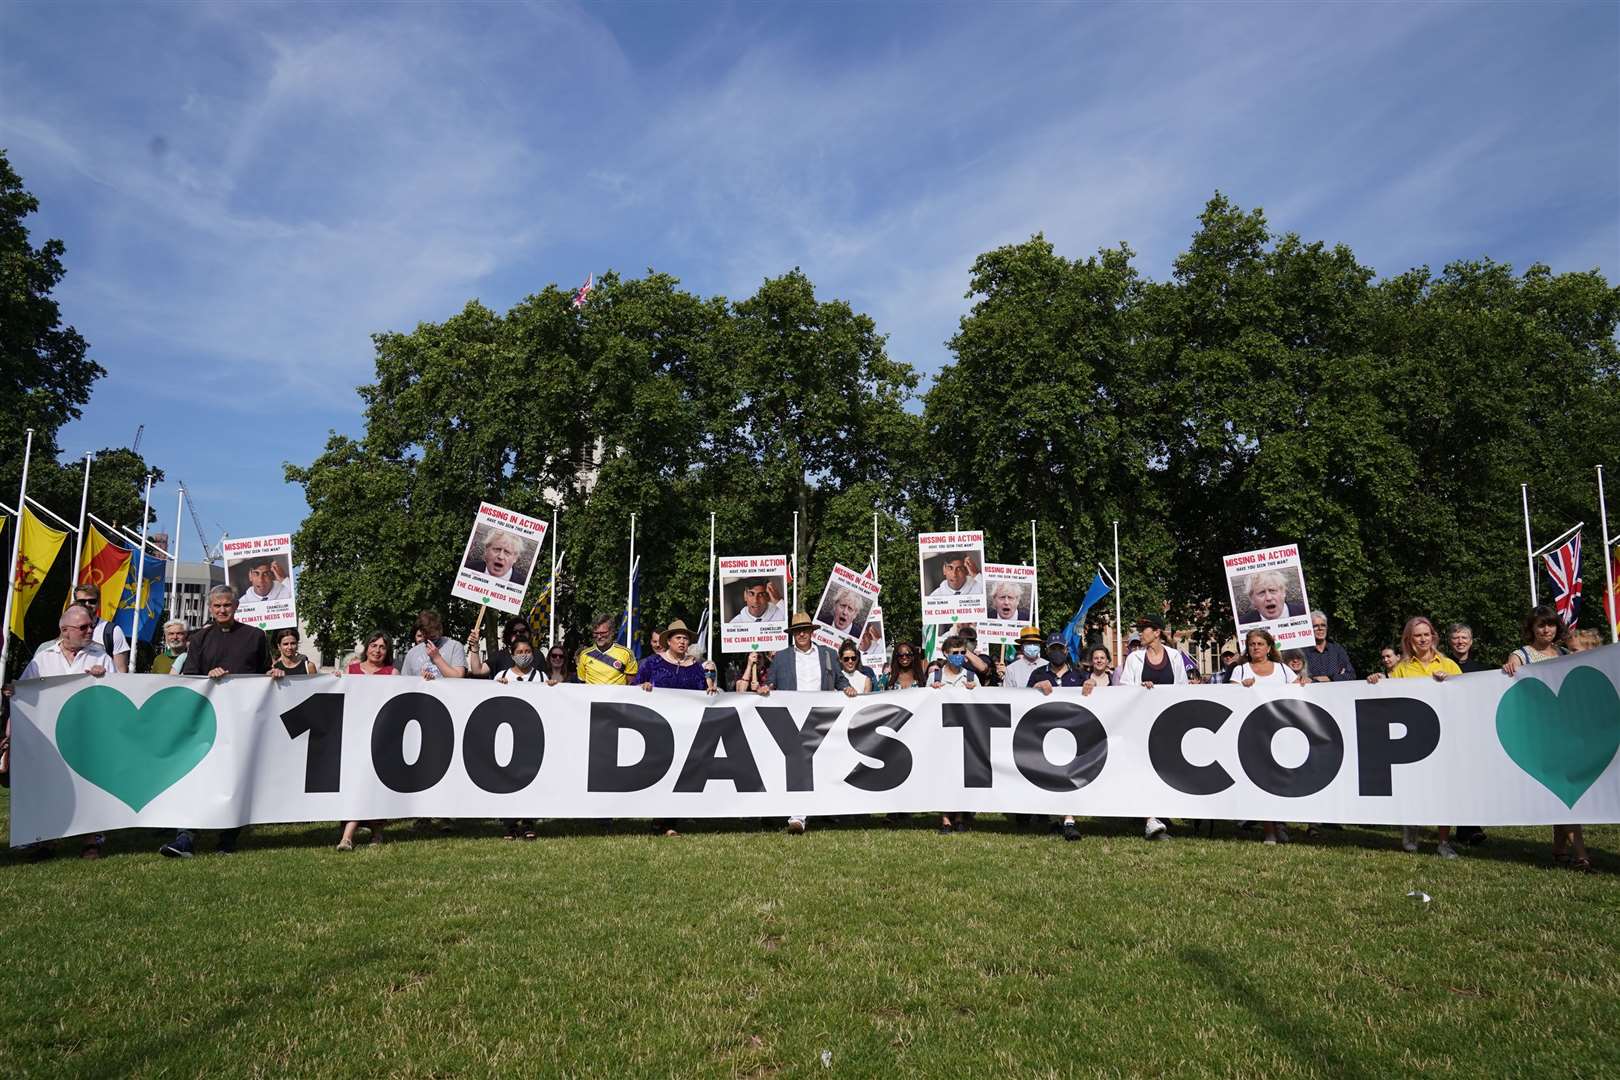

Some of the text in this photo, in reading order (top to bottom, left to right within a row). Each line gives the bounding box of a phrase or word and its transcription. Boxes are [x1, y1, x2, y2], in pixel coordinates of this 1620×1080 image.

[480, 505, 546, 533] MISSING IN ACTION
[224, 537, 289, 551] MISSING IN ACTION
[920, 534, 982, 544] MISSING IN ACTION
[720, 560, 748, 568] MISSING
[760, 559, 785, 567] ACTION
[1225, 548, 1297, 567] MISSING IN ACTION
[1014, 568, 1035, 576] ACTION
[834, 566, 880, 594] MISSING IN ACTION
[467, 584, 489, 596] CLIMATE
[490, 592, 507, 601] NEEDS
[508, 597, 521, 605] YOU!
[817, 633, 834, 647] CLIMATE
[1278, 632, 1296, 640] NEEDS
[280, 692, 1441, 799] 100 DAYS TO COP
